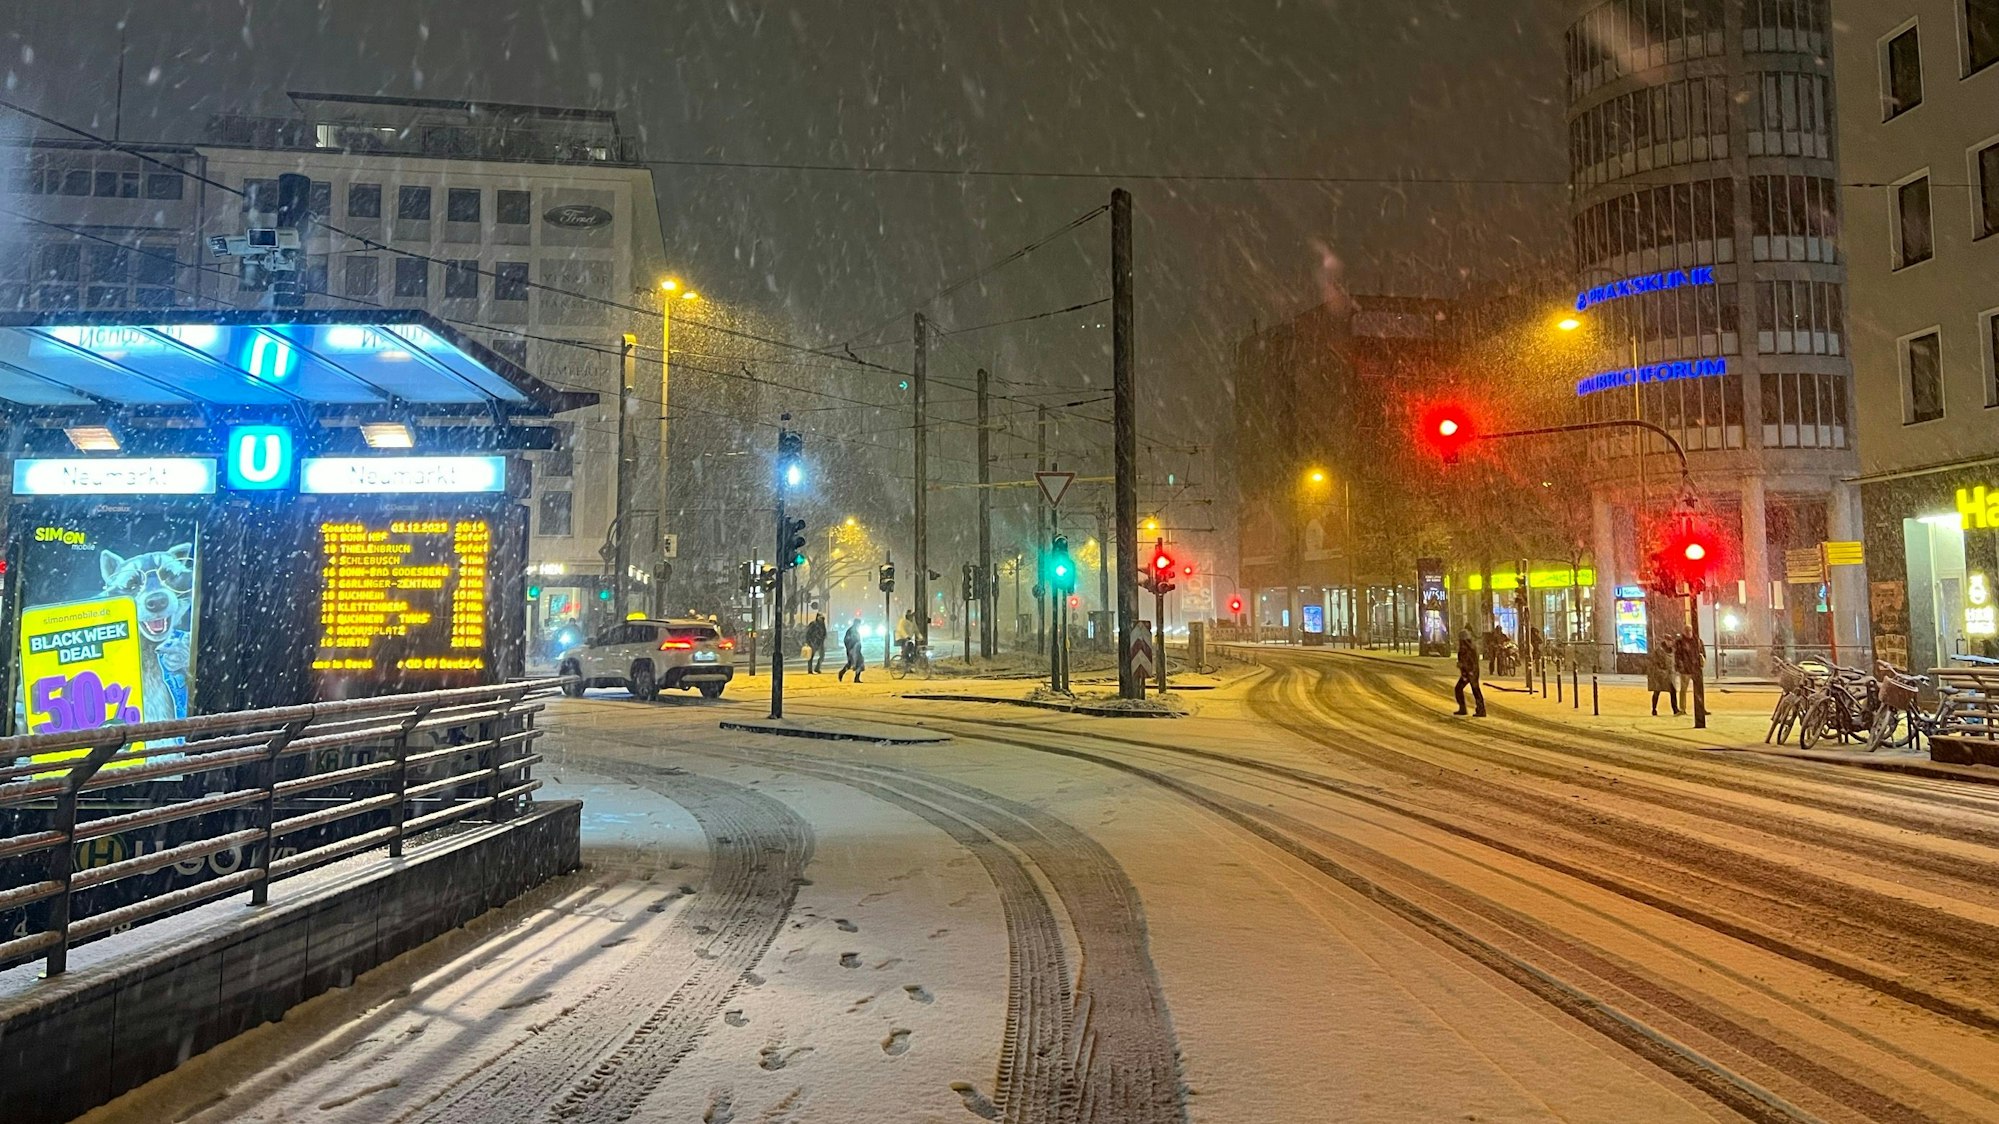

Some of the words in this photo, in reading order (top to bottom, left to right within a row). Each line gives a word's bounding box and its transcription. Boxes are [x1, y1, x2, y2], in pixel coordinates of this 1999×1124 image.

[240, 435, 281, 482] U
[63, 466, 167, 485] Neumarkt
[351, 465, 456, 485] Neumarkt
[35, 527, 85, 545] SIMON
[454, 532, 489, 542] Sofort
[71, 543, 96, 551] mobile
[340, 544, 411, 553] THIELENBRUCH
[454, 543, 488, 554] Sofort
[339, 556, 400, 565] SCHLEBUSCH
[339, 567, 389, 576] BONN-BAD
[392, 567, 449, 577] GODESBERG
[338, 590, 385, 600] BUCHHEIM
[338, 602, 408, 611] KLETTENBERG
[43, 608, 111, 624] simonmobile.de
[337, 625, 406, 635] ROCHUSPLATZ
[31, 630, 83, 652] BLACK
[84, 623, 128, 643] WEEK
[59, 644, 102, 663] DEAL
[31, 670, 141, 734] 50%
